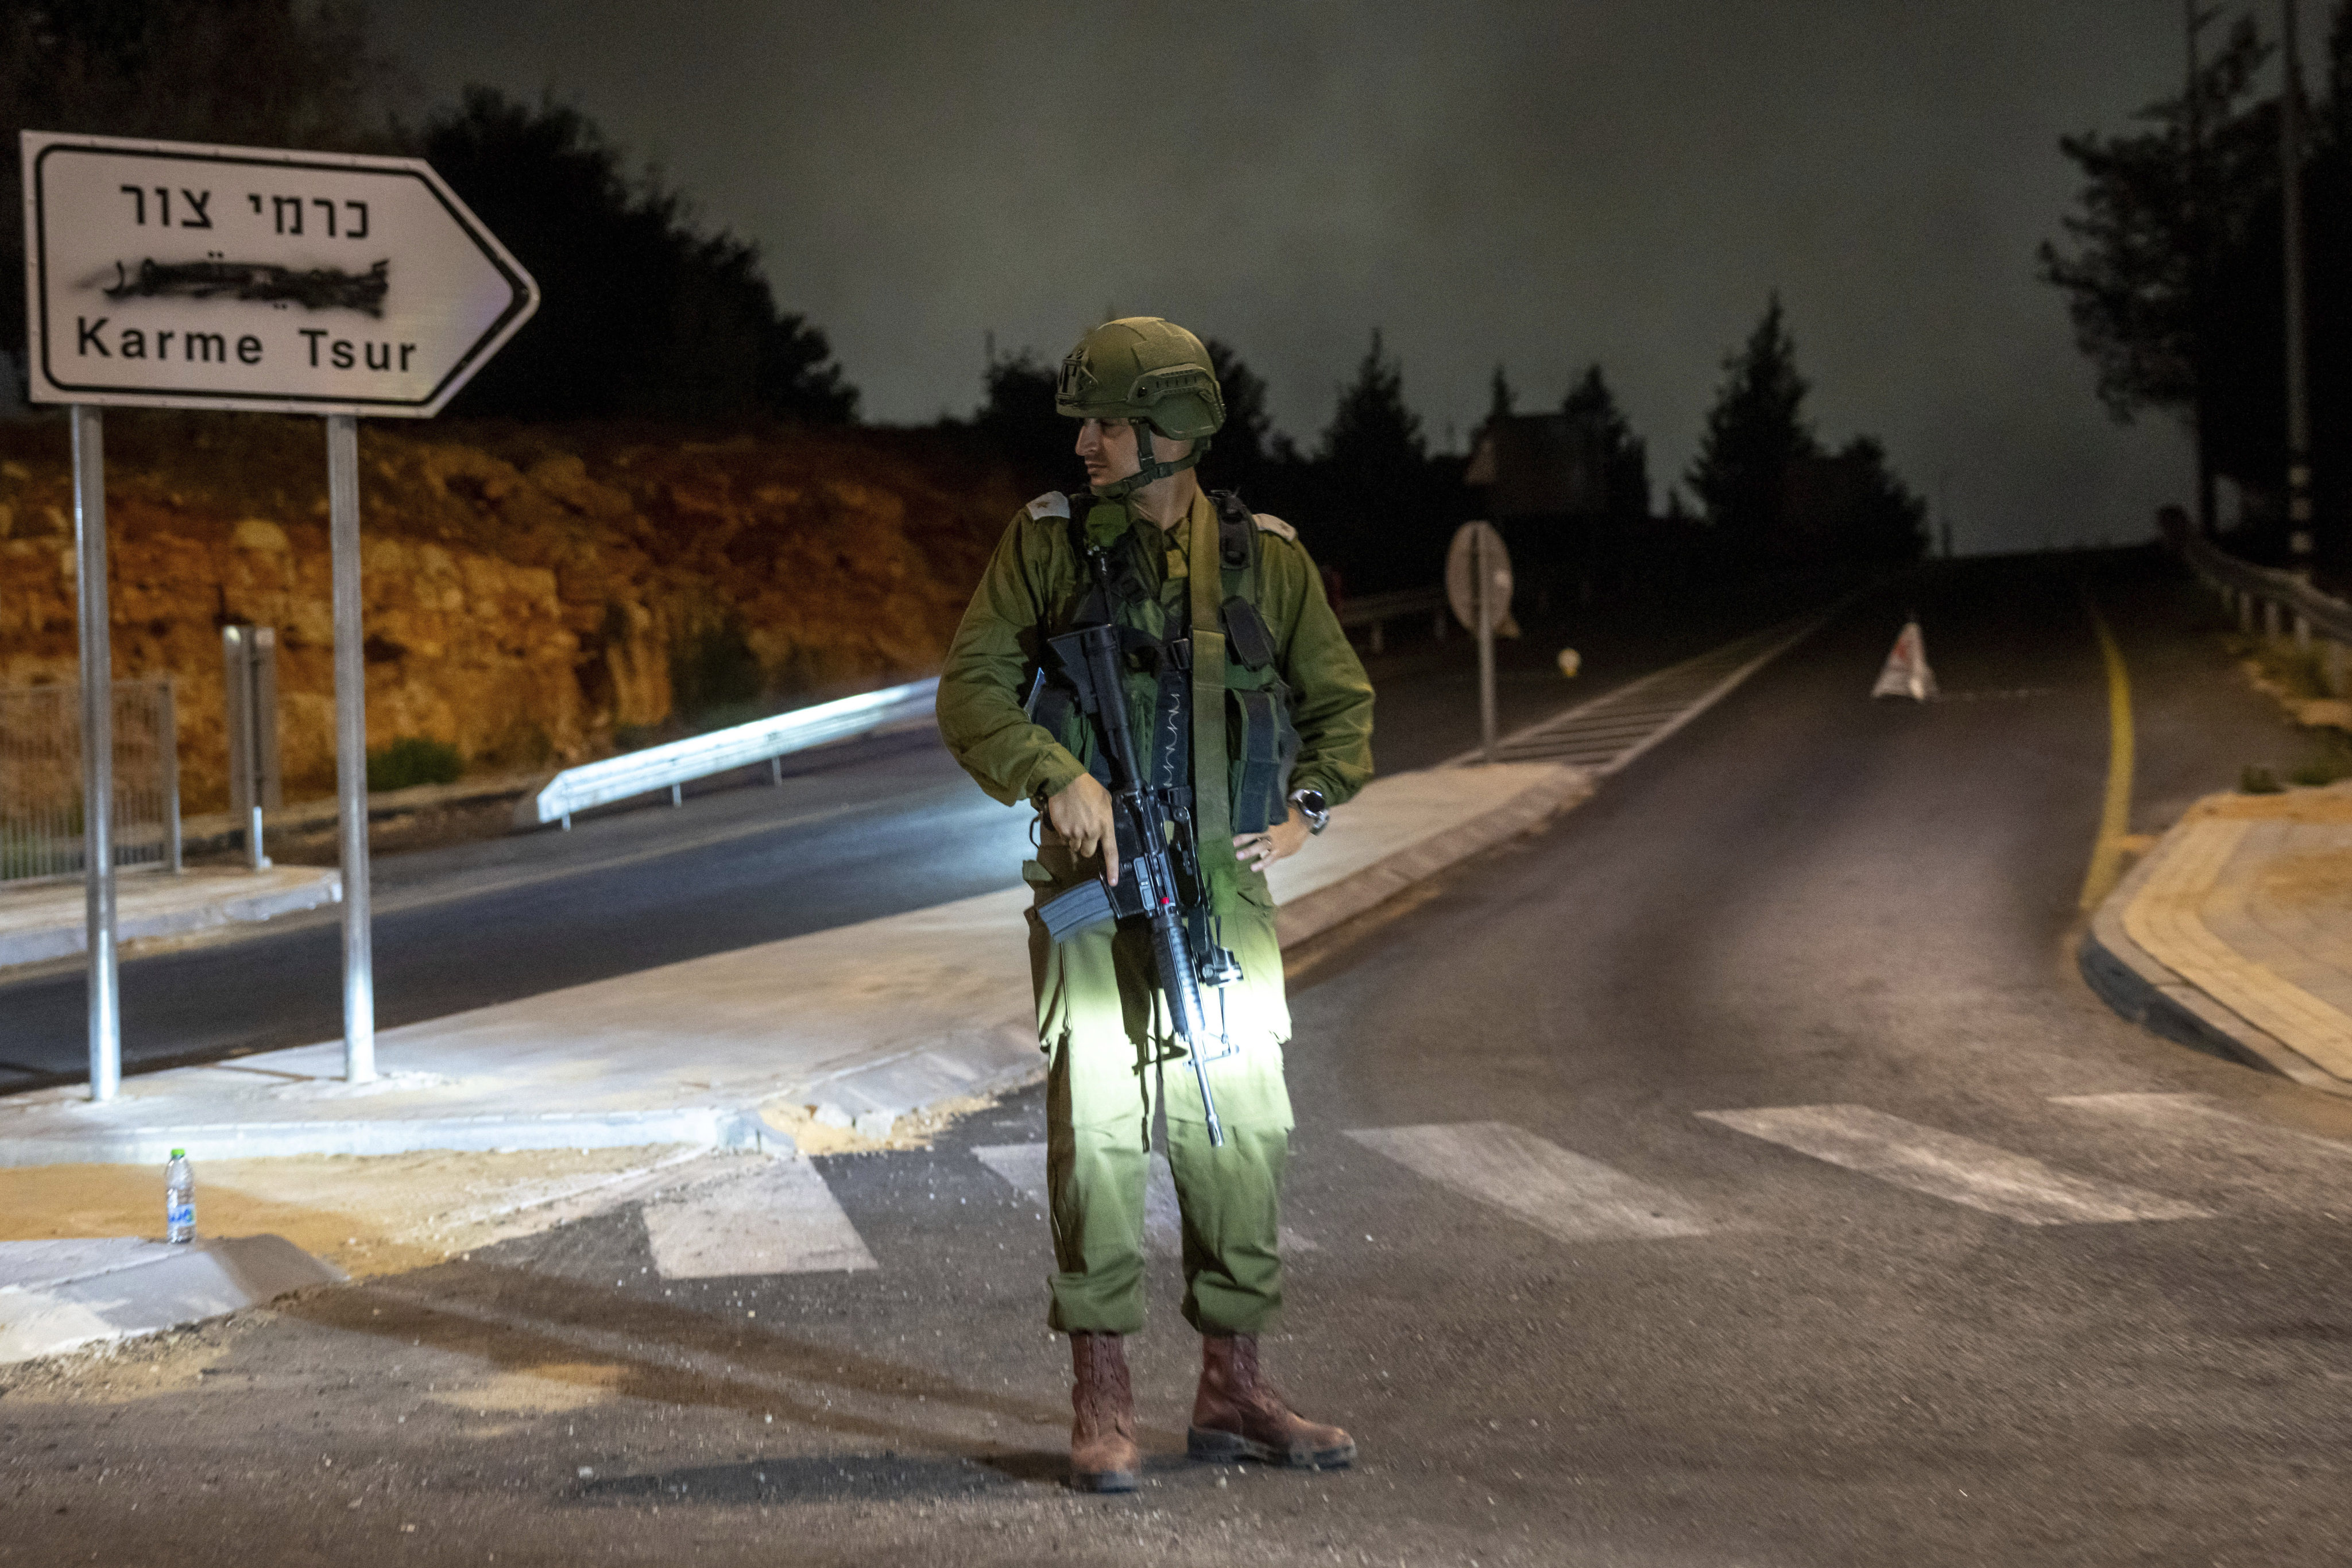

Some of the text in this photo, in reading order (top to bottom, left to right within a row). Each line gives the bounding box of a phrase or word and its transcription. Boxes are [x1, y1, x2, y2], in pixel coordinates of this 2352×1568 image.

[119, 184, 369, 240] כרמי צור
[76, 315, 417, 372] Karme Tsur
